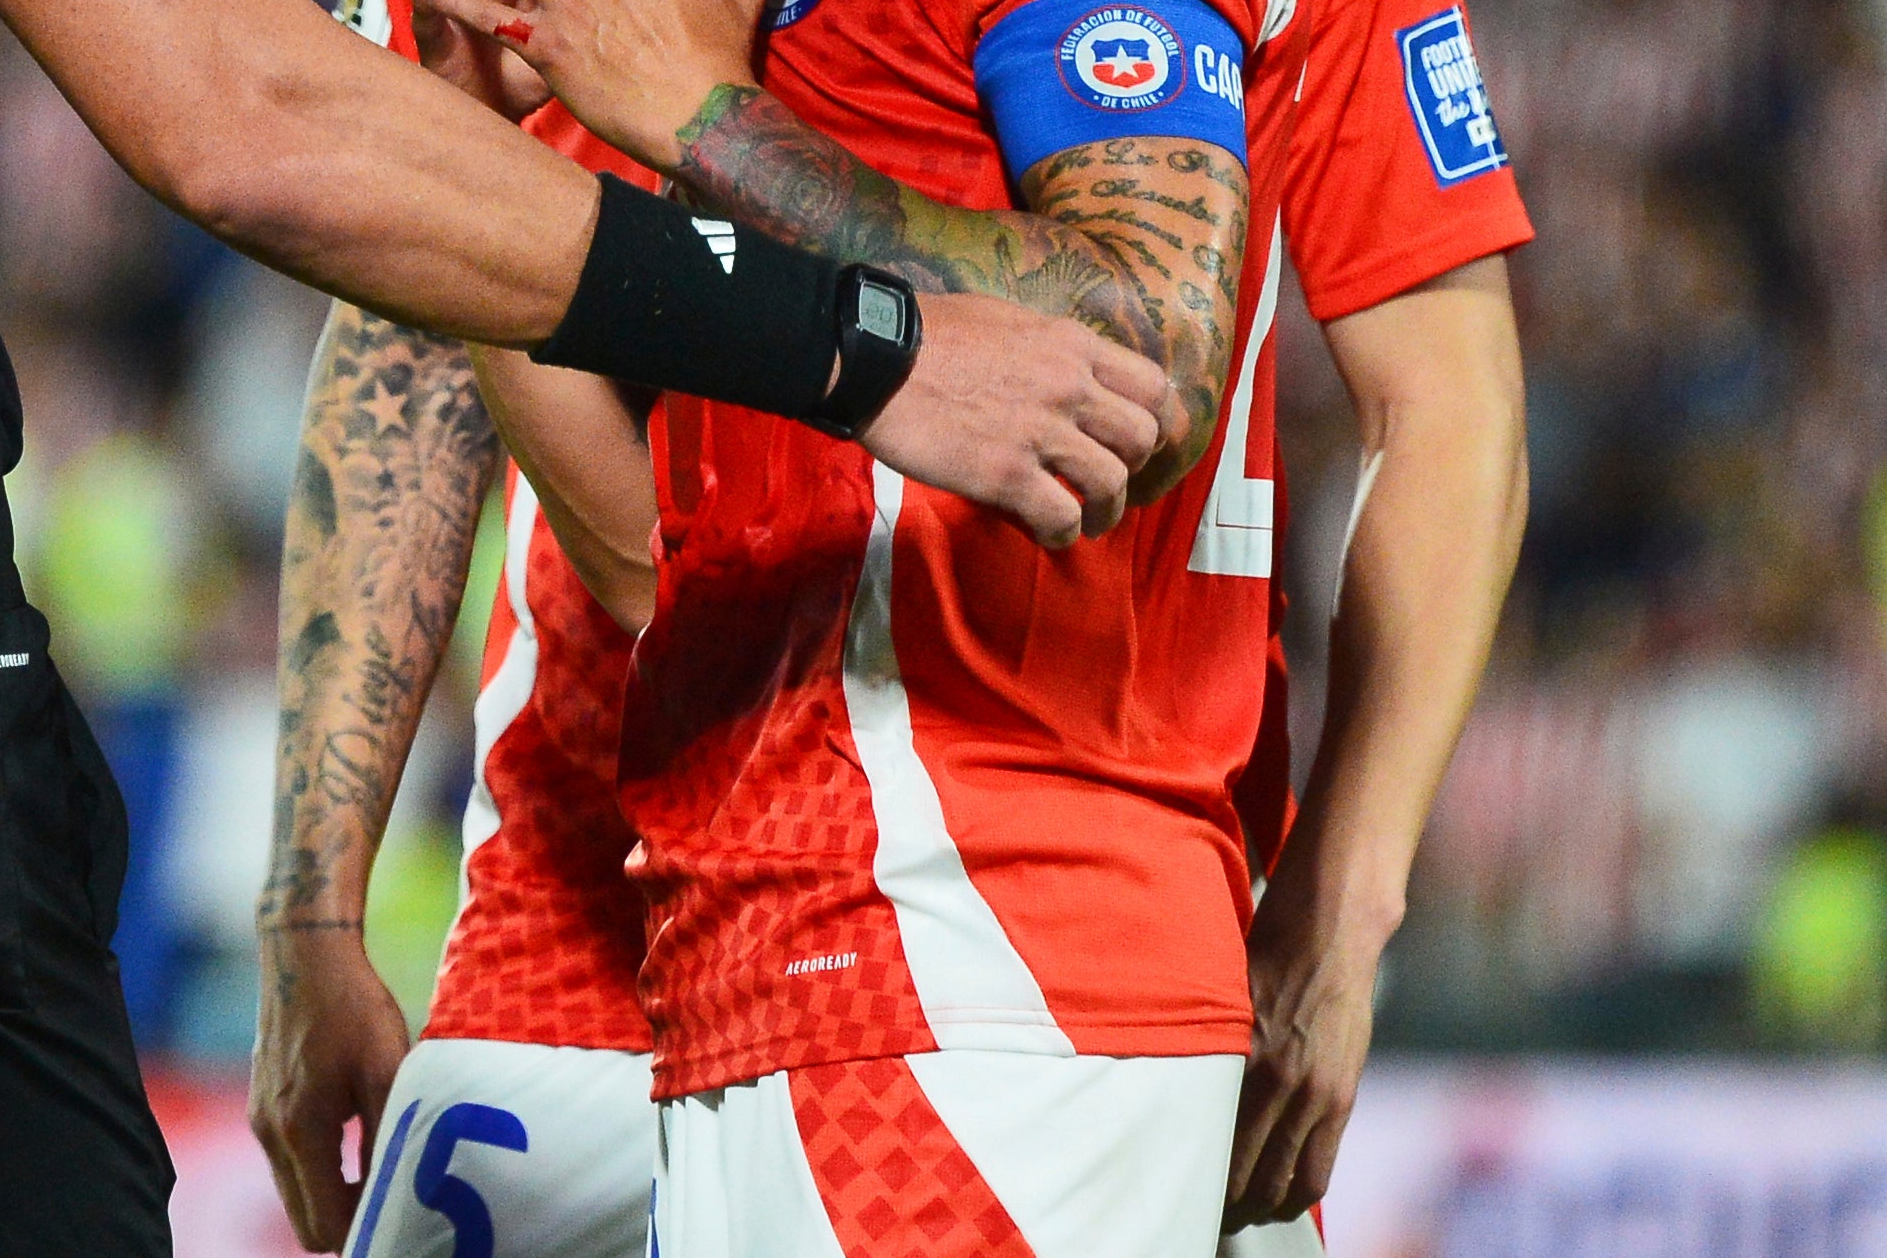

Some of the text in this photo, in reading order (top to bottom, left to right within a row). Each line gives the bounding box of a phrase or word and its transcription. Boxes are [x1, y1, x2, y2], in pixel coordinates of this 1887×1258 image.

[1125, 9, 1142, 24] DE
[1143, 15, 1181, 58] FUTBOL
[1101, 92, 1159, 109] DE CHILE
[785, 951, 858, 977] AEROREADY
